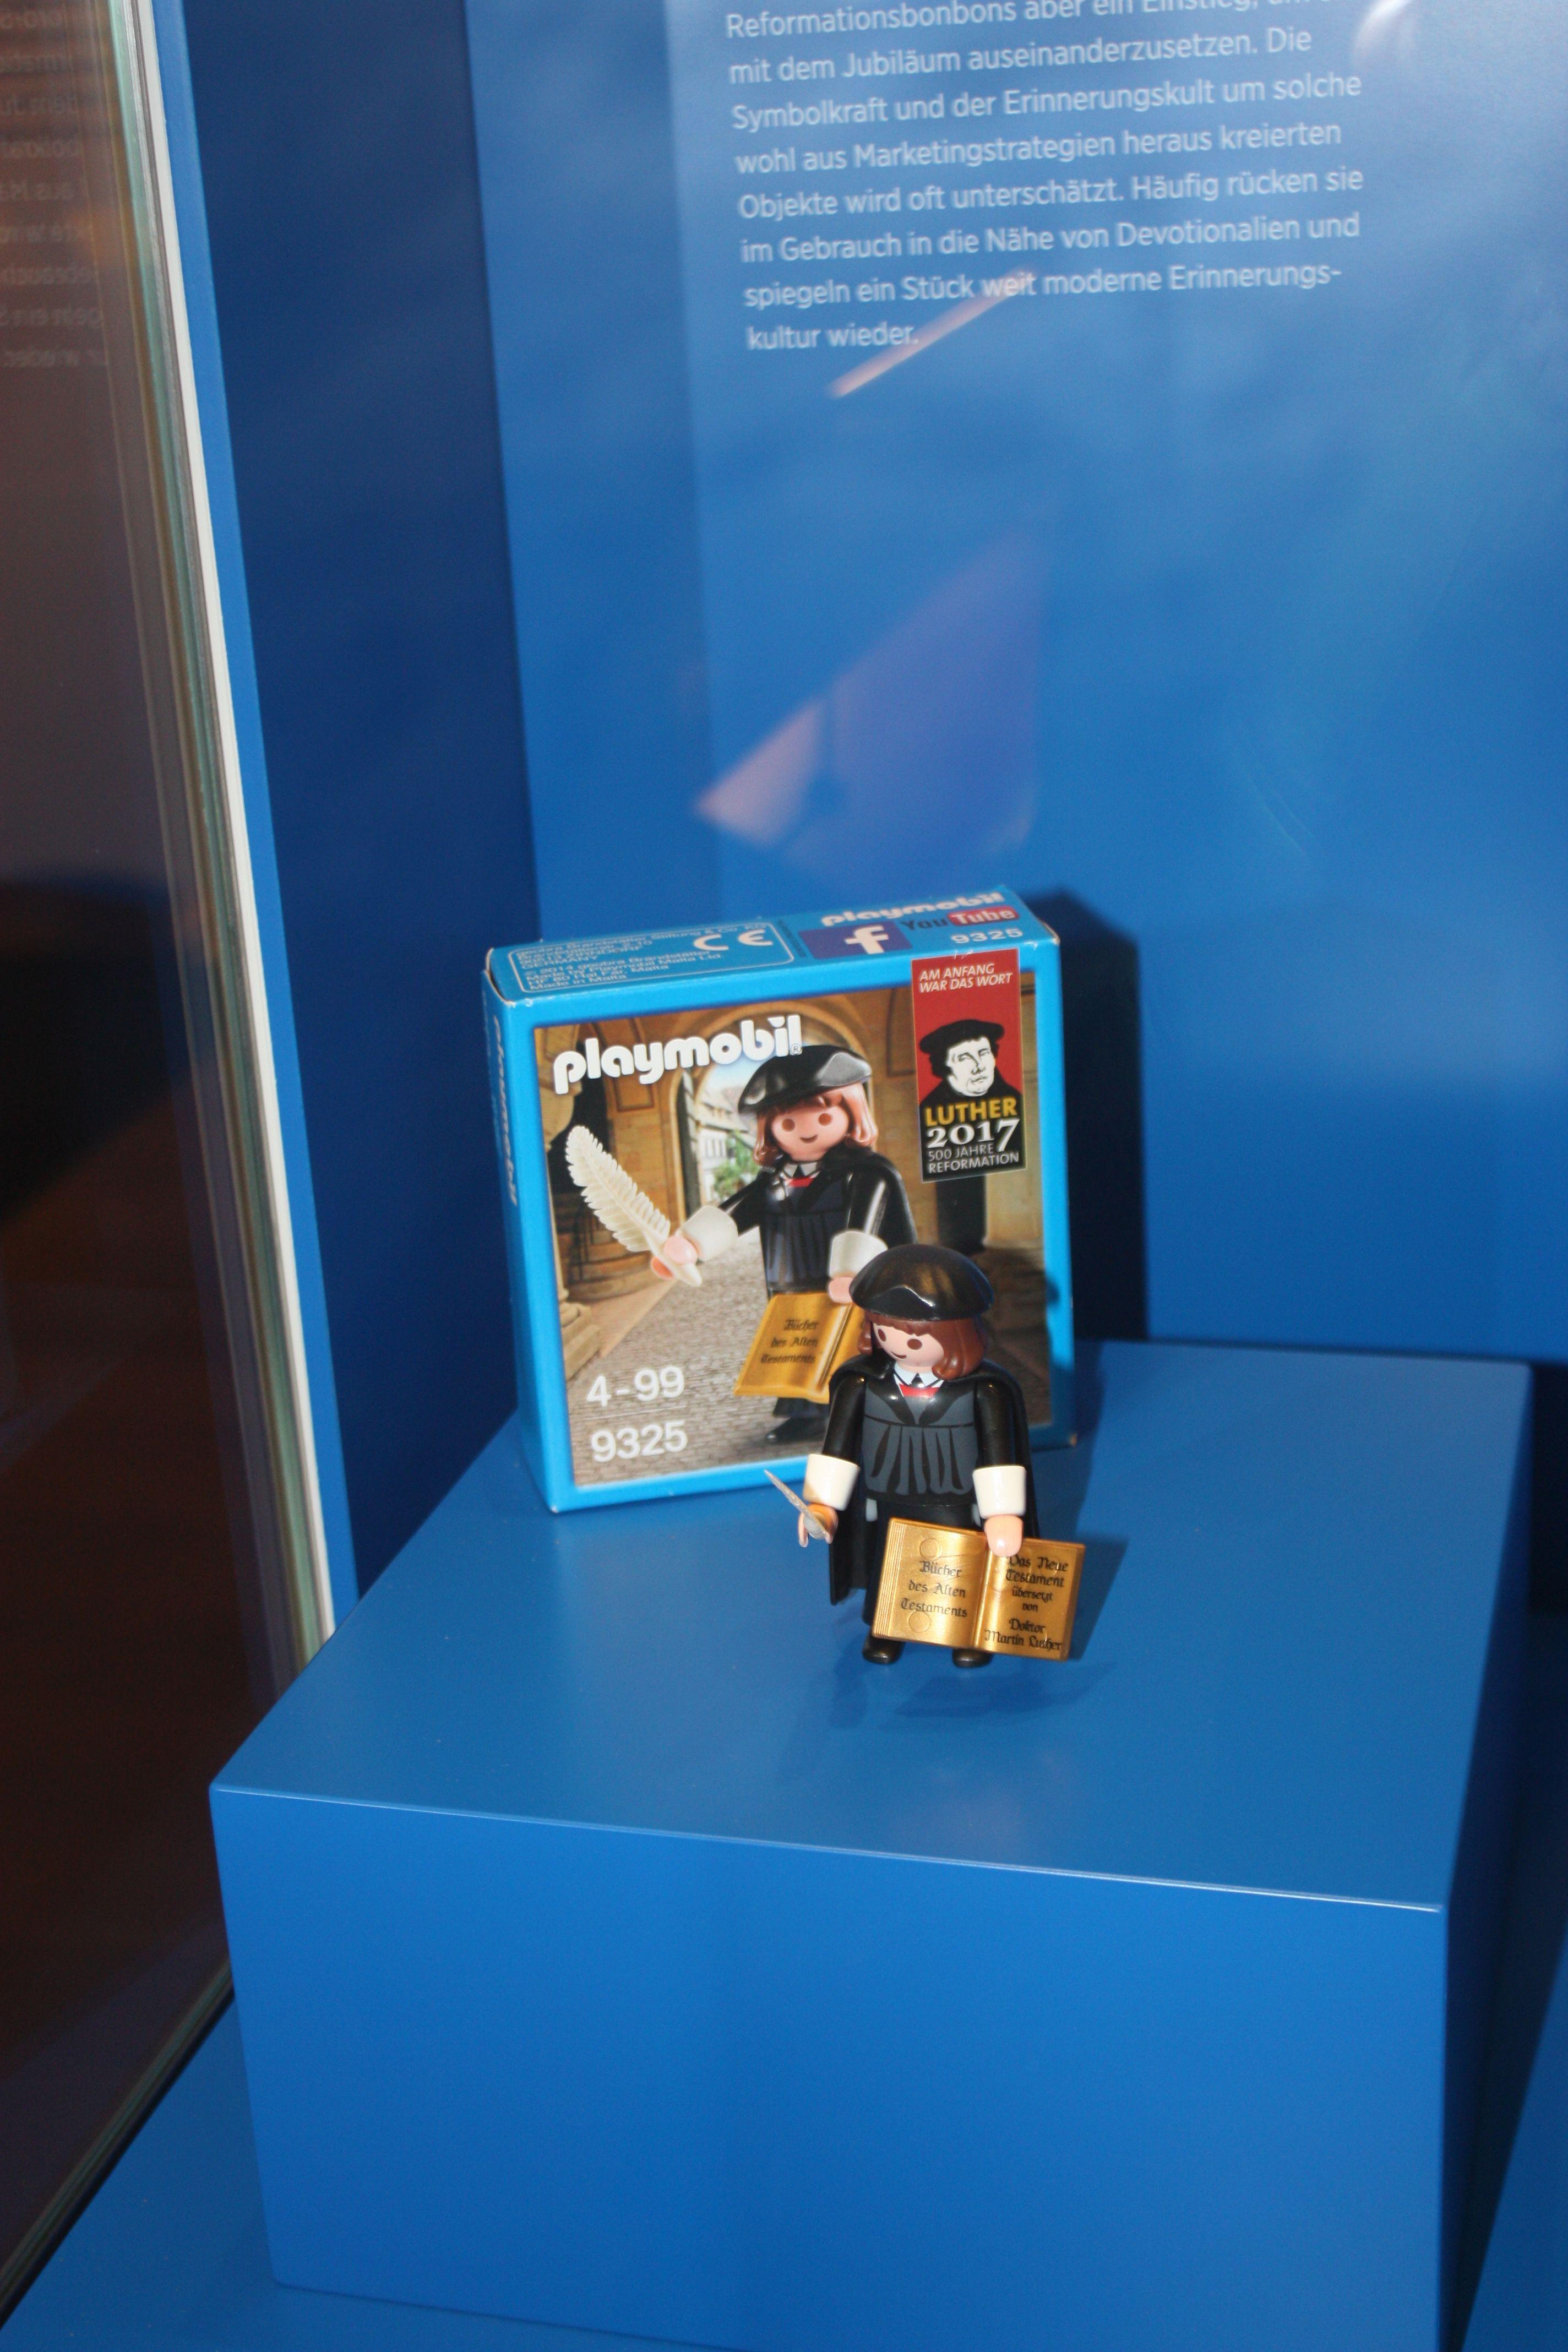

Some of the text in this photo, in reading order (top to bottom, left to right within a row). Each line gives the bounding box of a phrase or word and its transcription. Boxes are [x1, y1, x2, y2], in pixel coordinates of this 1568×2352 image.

[727, 0, 1016, 37] Reformationsbonbons
[1025, 0, 1082, 19] aber
[729, 26, 1312, 84] mit dem Jubiläum auseinanderzusetzen. Die
[732, 72, 1362, 133] Symbolkraft und der Erinnerungskult um solche
[735, 123, 1341, 174] wohl aus Marketingstrategien heraus kreierten
[738, 166, 1364, 221] Objekte wird oft unterschätzt. Häufig rücken sie
[741, 212, 1360, 263] im Gebrauch in die Nähe von Devotionalien und
[743, 264, 1342, 311] spiegeln ein Stück weit moderne Erinnerungs-
[747, 322, 918, 350] kultur wieder.
[821, 892, 1005, 926] playmobil
[951, 927, 1023, 944] 9325
[529, 981, 569, 990] Made
[588, 973, 627, 982] Malta
[919, 963, 995, 981] AM ANFANG
[920, 973, 1012, 993] WAR DAS WORT
[553, 1015, 802, 1095] playmobil
[925, 1097, 1017, 1127] LUTHER
[927, 1118, 1020, 1152] 2017
[929, 1143, 994, 1162] 500 JAHRE
[929, 1152, 1019, 1173] REFORMATION
[784, 1319, 819, 1332] Bücher
[761, 1353, 816, 1364] Testaments
[587, 1365, 684, 1407] 4-99
[591, 1419, 688, 1462] 9325
[920, 1560, 962, 1577] Bücher
[1009, 1554, 1068, 1572] Das Neue
[1006, 1569, 1064, 1587] Testament
[909, 1580, 966, 1598] des Alten
[1012, 1586, 1053, 1602] übersetzt
[901, 1598, 968, 1618] Testaments
[1022, 1603, 1038, 1611] von
[1009, 1618, 1046, 1634] Doktor
[985, 1630, 1063, 1651] Martin Luther
